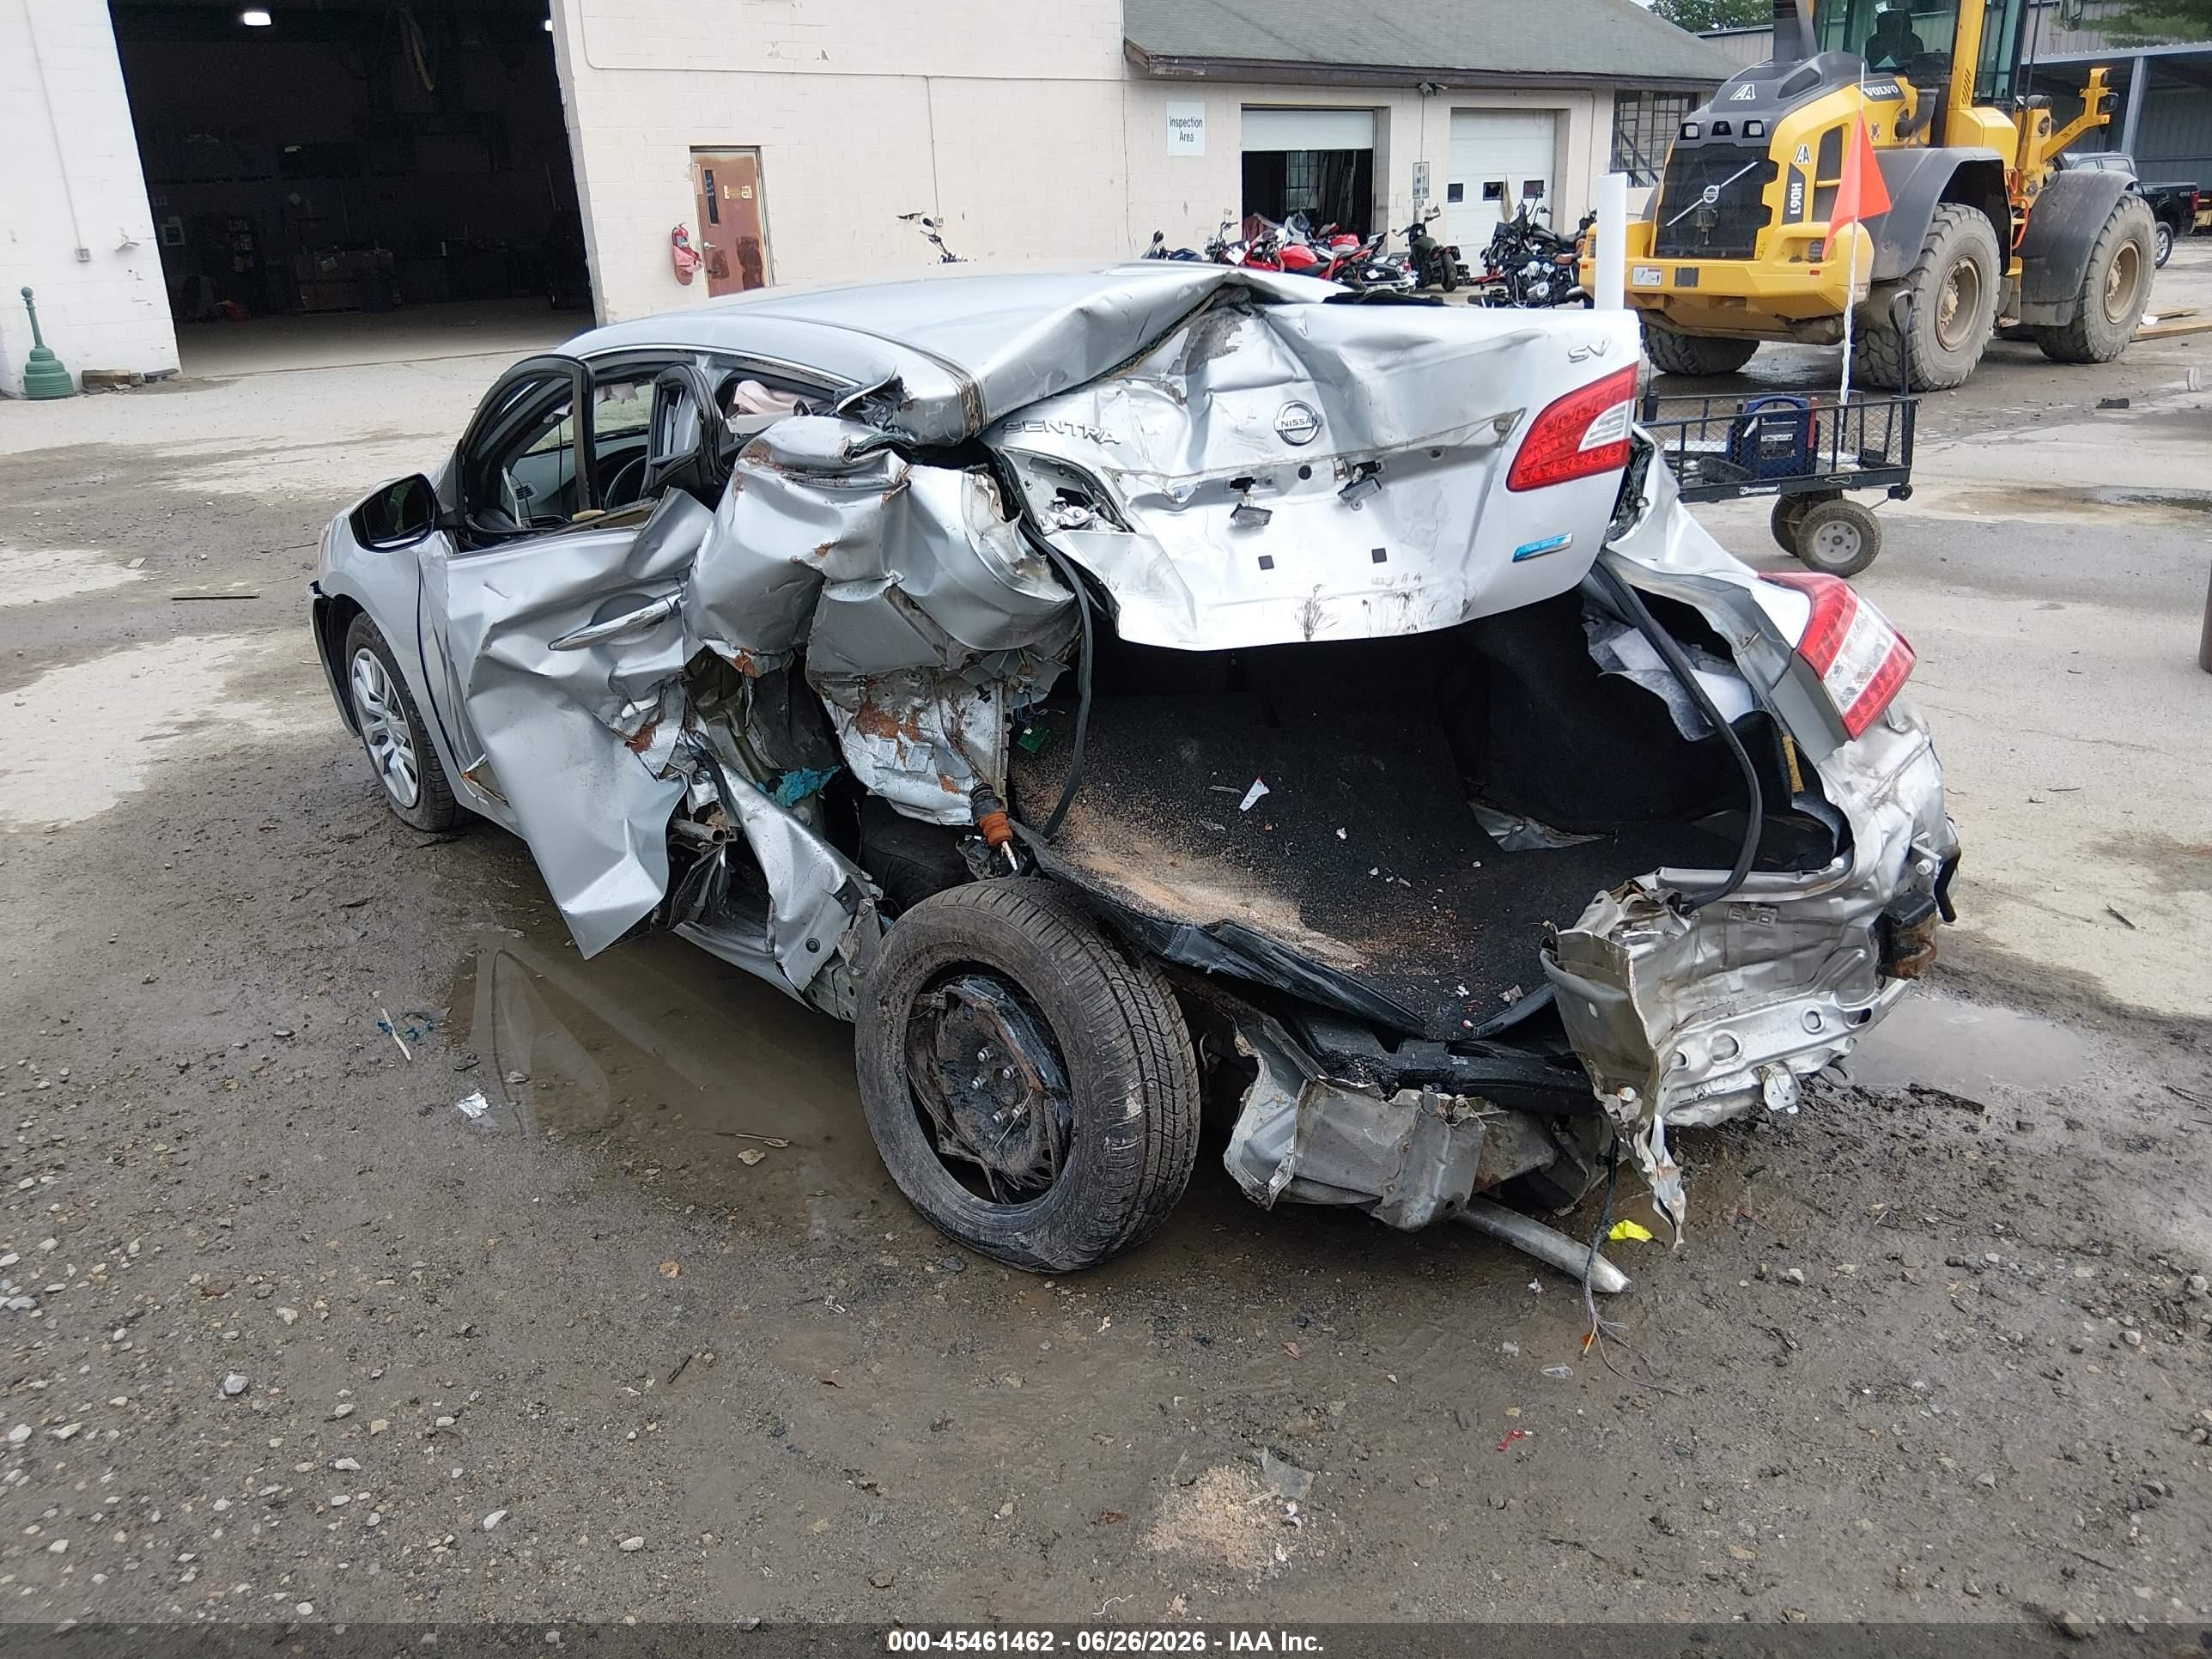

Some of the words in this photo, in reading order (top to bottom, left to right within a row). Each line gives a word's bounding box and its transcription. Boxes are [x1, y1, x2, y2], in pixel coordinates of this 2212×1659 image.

[1863, 84, 1899, 97] VOLVO
[1169, 116, 1203, 129] Inspection
[1178, 130, 1194, 143] Area
[1790, 182, 1802, 215] L90H
[1567, 337, 1612, 364] SV
[1280, 416, 1318, 428] NISSAN
[1002, 419, 1121, 445] SENTRA
